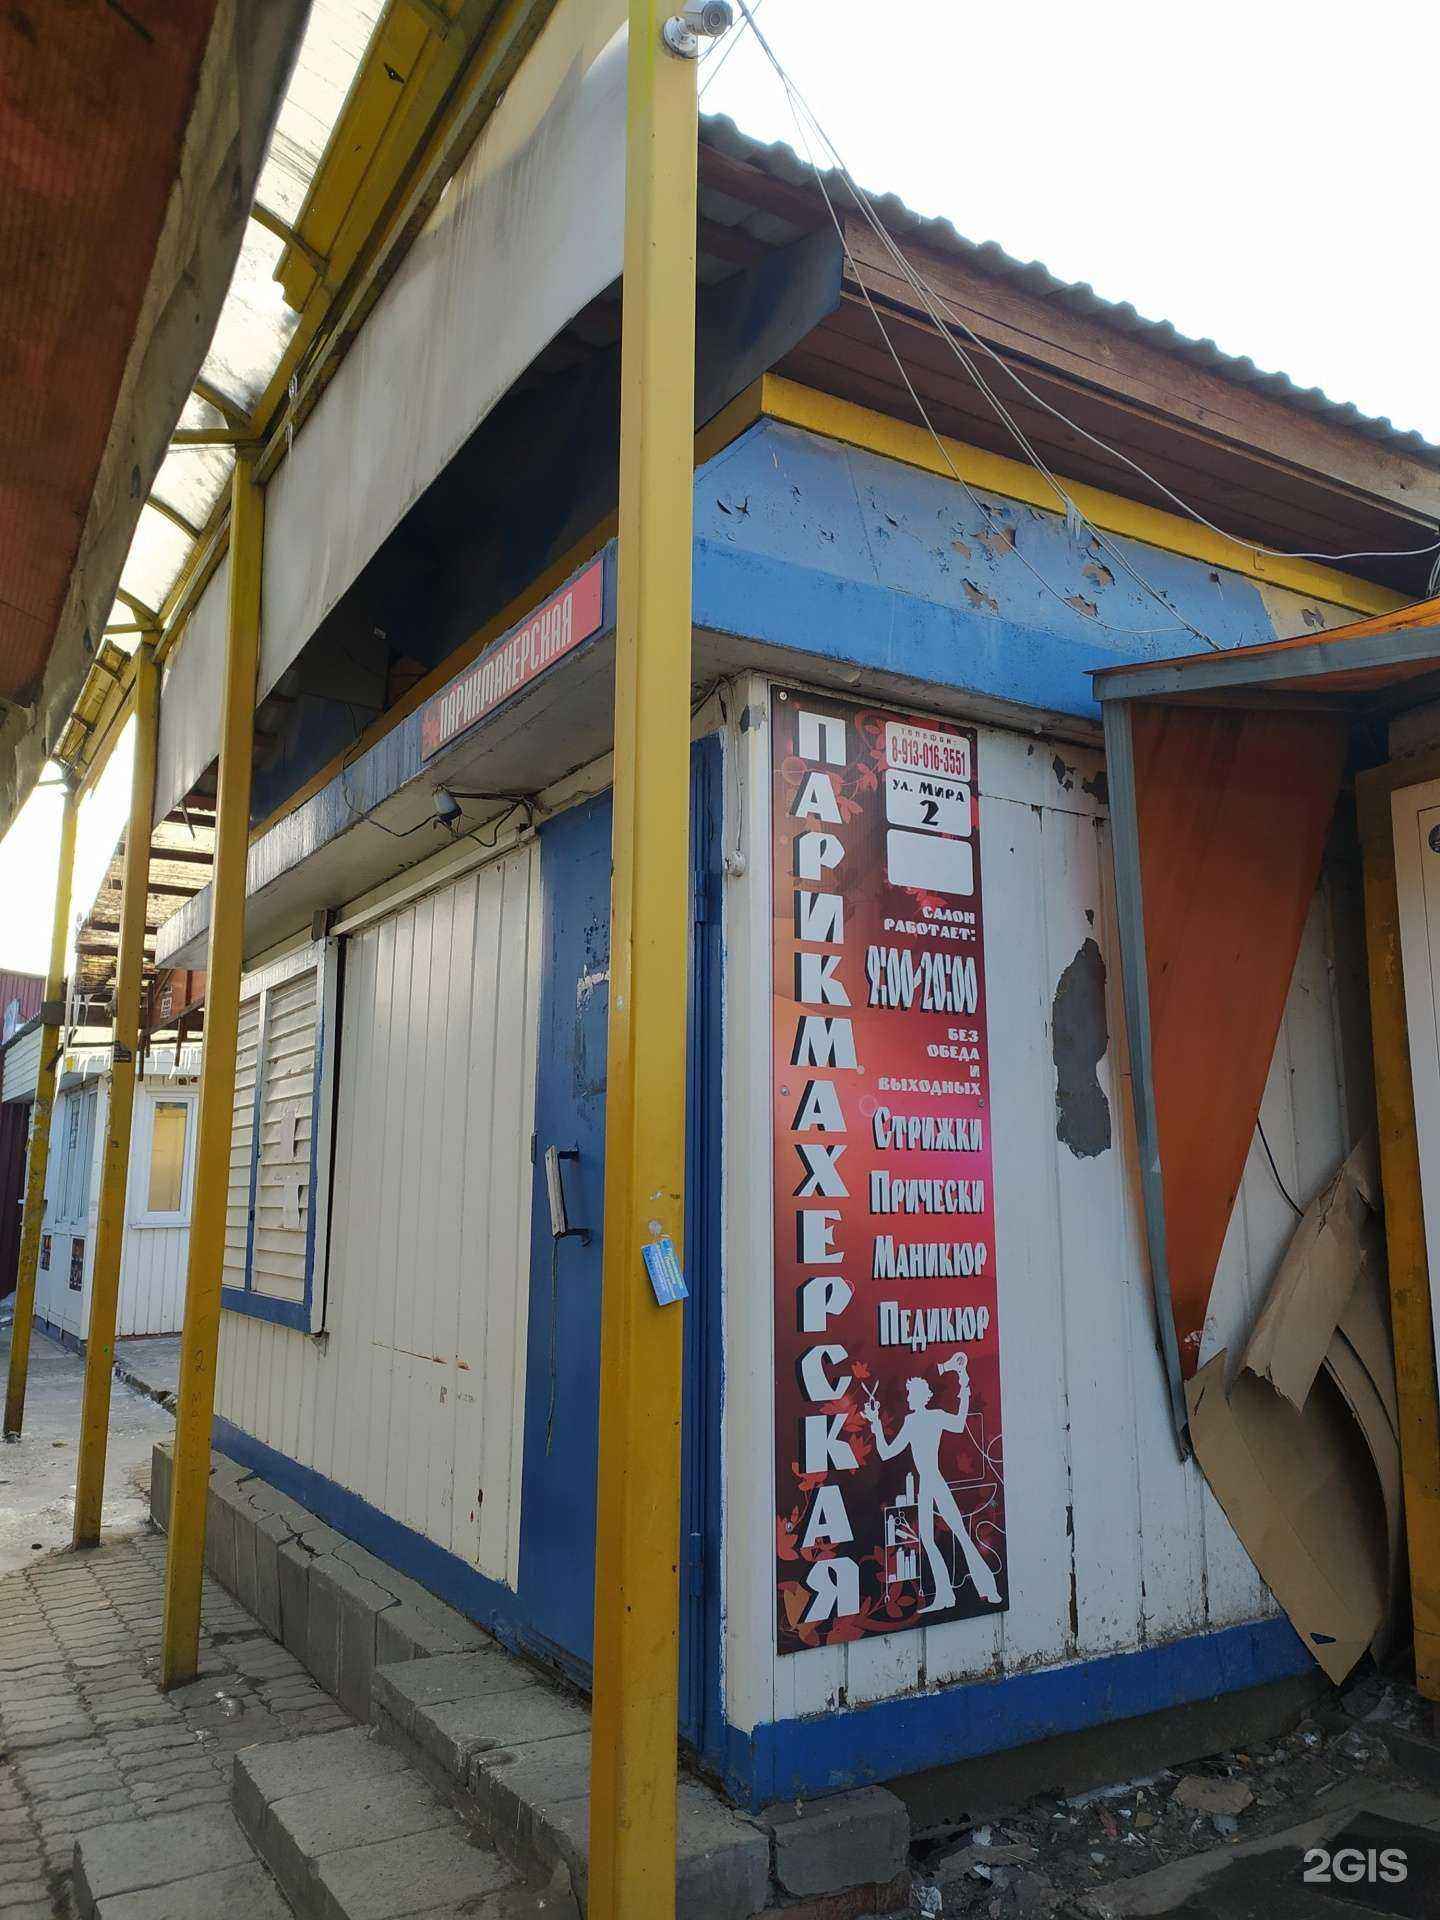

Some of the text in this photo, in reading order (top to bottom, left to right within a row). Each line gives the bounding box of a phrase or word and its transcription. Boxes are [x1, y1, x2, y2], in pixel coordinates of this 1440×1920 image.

[439, 591, 573, 742] ПАРИКМАХЕРСКАЯ
[892, 736, 966, 777] 8-913-016-3551
[919, 799, 940, 826] 2
[922, 905, 976, 925] САЛОН
[883, 917, 976, 942] РАБОТАЕТ:
[947, 1027, 978, 1043] БЕЗ
[926, 1043, 981, 1062] ОБЕДА
[969, 1064, 981, 1078] И
[878, 1076, 982, 1096] ВЫХОДНЫХ
[793, 710, 861, 1623] ПАРИКМАХЕРСКАЯ
